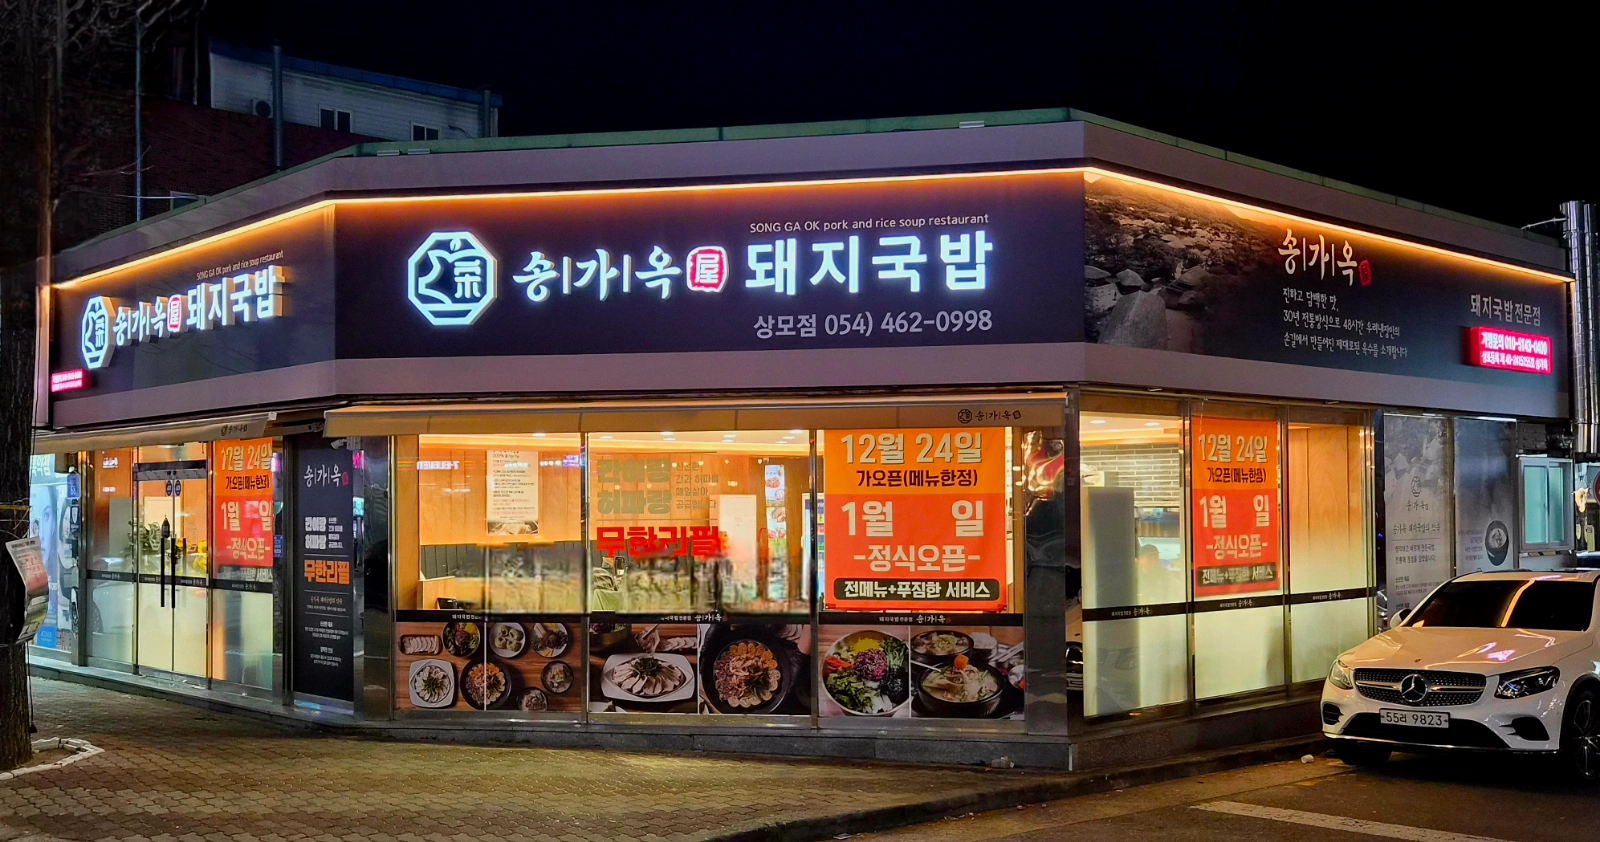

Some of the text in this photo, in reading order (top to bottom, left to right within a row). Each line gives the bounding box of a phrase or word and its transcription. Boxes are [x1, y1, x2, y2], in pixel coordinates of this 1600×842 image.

[750, 214, 989, 233] SONG GA OK pork and rice soup restaurant
[222, 264, 232, 274] pork
[232, 262, 240, 271] and
[241, 260, 249, 269] rice
[260, 250, 284, 263] restaurant
[745, 230, 993, 296] 돼지국밥
[186, 265, 281, 330] 돼지국밥
[1283, 287, 1304, 304] 진하고
[1306, 291, 1327, 309] 담백한
[754, 310, 992, 339] 상모점 054) 462-0998
[1283, 310, 1299, 327] 30년
[1302, 312, 1341, 330] 전통방식으로
[1343, 319, 1364, 336] 48시간
[1284, 332, 1308, 348] 손길에서
[1310, 335, 1334, 352] 만들어진
[1336, 339, 1360, 355] 제대로된
[1482, 332, 1504, 350] 가맹문의
[221, 442, 272, 472] 12월 24일
[841, 432, 983, 464] 12월 24일
[1200, 434, 1268, 463] 12월 24일
[856, 469, 978, 487] 가오픈(메뉴한정)
[1208, 467, 1266, 484] 가오픈(메뉴한정)
[221, 500, 272, 532] 1월 일
[841, 500, 984, 537] 1월 일
[1200, 494, 1270, 528] 1월 일
[596, 526, 718, 557] 무한리필
[853, 544, 980, 572] -정식오픈-
[304, 560, 350, 585] 무한리필
[844, 580, 991, 599] 전메뉴+푸짐한 서비스
[1412, 714, 1442, 726] 9823
